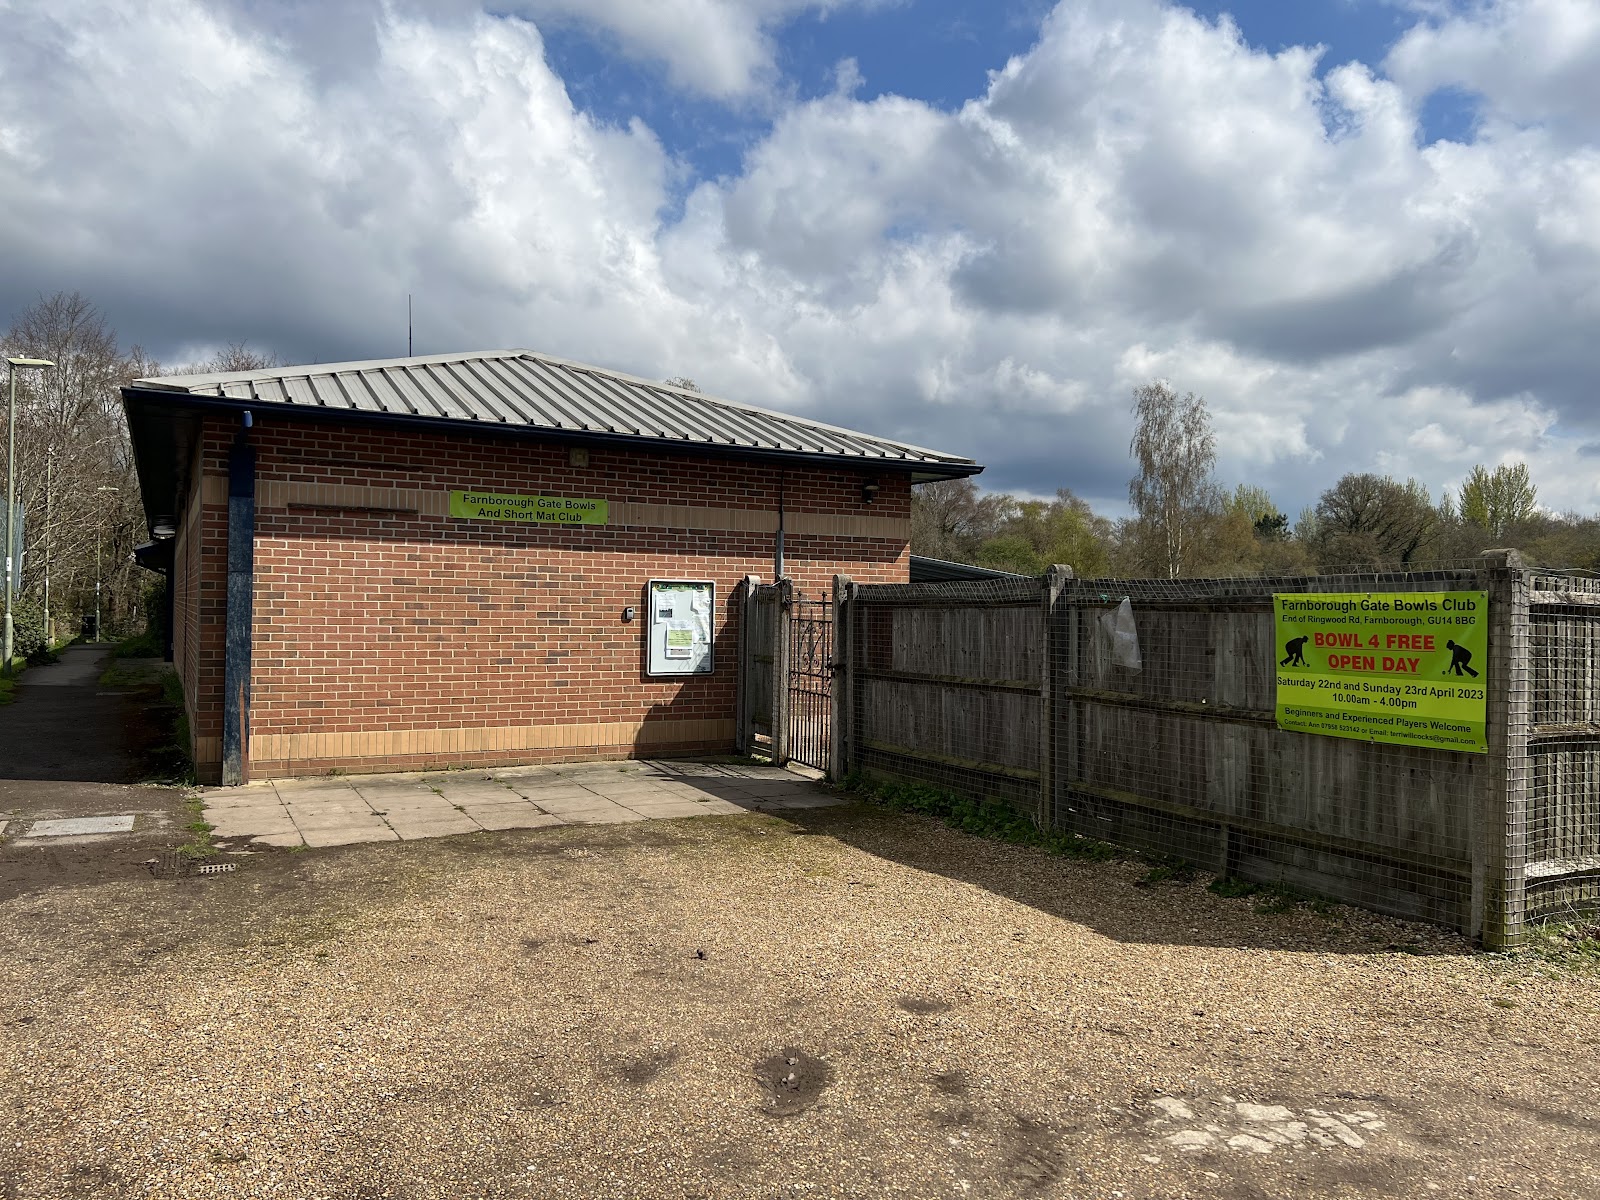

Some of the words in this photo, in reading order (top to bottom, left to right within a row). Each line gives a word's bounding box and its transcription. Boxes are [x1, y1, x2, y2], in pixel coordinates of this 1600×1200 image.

[463, 494, 534, 508] Farnborough
[537, 499, 562, 509] Gate
[565, 500, 596, 510] Bowls
[478, 508, 501, 518] And
[504, 509, 533, 519] Short
[536, 511, 555, 520] Mat
[558, 512, 582, 521] Club
[1282, 599, 1356, 613] Farnborough
[1360, 599, 1390, 611] Gate
[1394, 599, 1437, 611] Bowls
[1442, 598, 1476, 611] Club
[1282, 615, 1297, 623] End
[1298, 615, 1306, 623] of
[1308, 616, 1346, 624] Ringwood
[1364, 616, 1425, 627] Farnborough,
[1427, 616, 1452, 625] GU14
[1455, 616, 1476, 625] 8BG
[1314, 632, 1363, 648] BOWL
[1368, 634, 1380, 648] 4
[1386, 634, 1435, 649] FREE
[1328, 654, 1375, 671] OPEN
[1382, 657, 1421, 673] DAY
[1277, 676, 1316, 689] Saturday
[1318, 679, 1341, 690] 22nd
[1343, 682, 1360, 691] and
[1362, 682, 1401, 696] Sunday
[1404, 685, 1427, 696] 23rd
[1429, 687, 1455, 699] April
[1457, 688, 1484, 700] 2023
[1332, 692, 1370, 704] 10.00am
[1379, 696, 1417, 709] 4.00pm
[1284, 707, 1323, 718] Beginners
[1325, 712, 1340, 720] and
[1342, 712, 1394, 725] Experienced
[1396, 717, 1428, 729] Players
[1429, 720, 1471, 733] Welcome
[1284, 719, 1307, 727] Contact:
[1369, 728, 1389, 736] Email:
